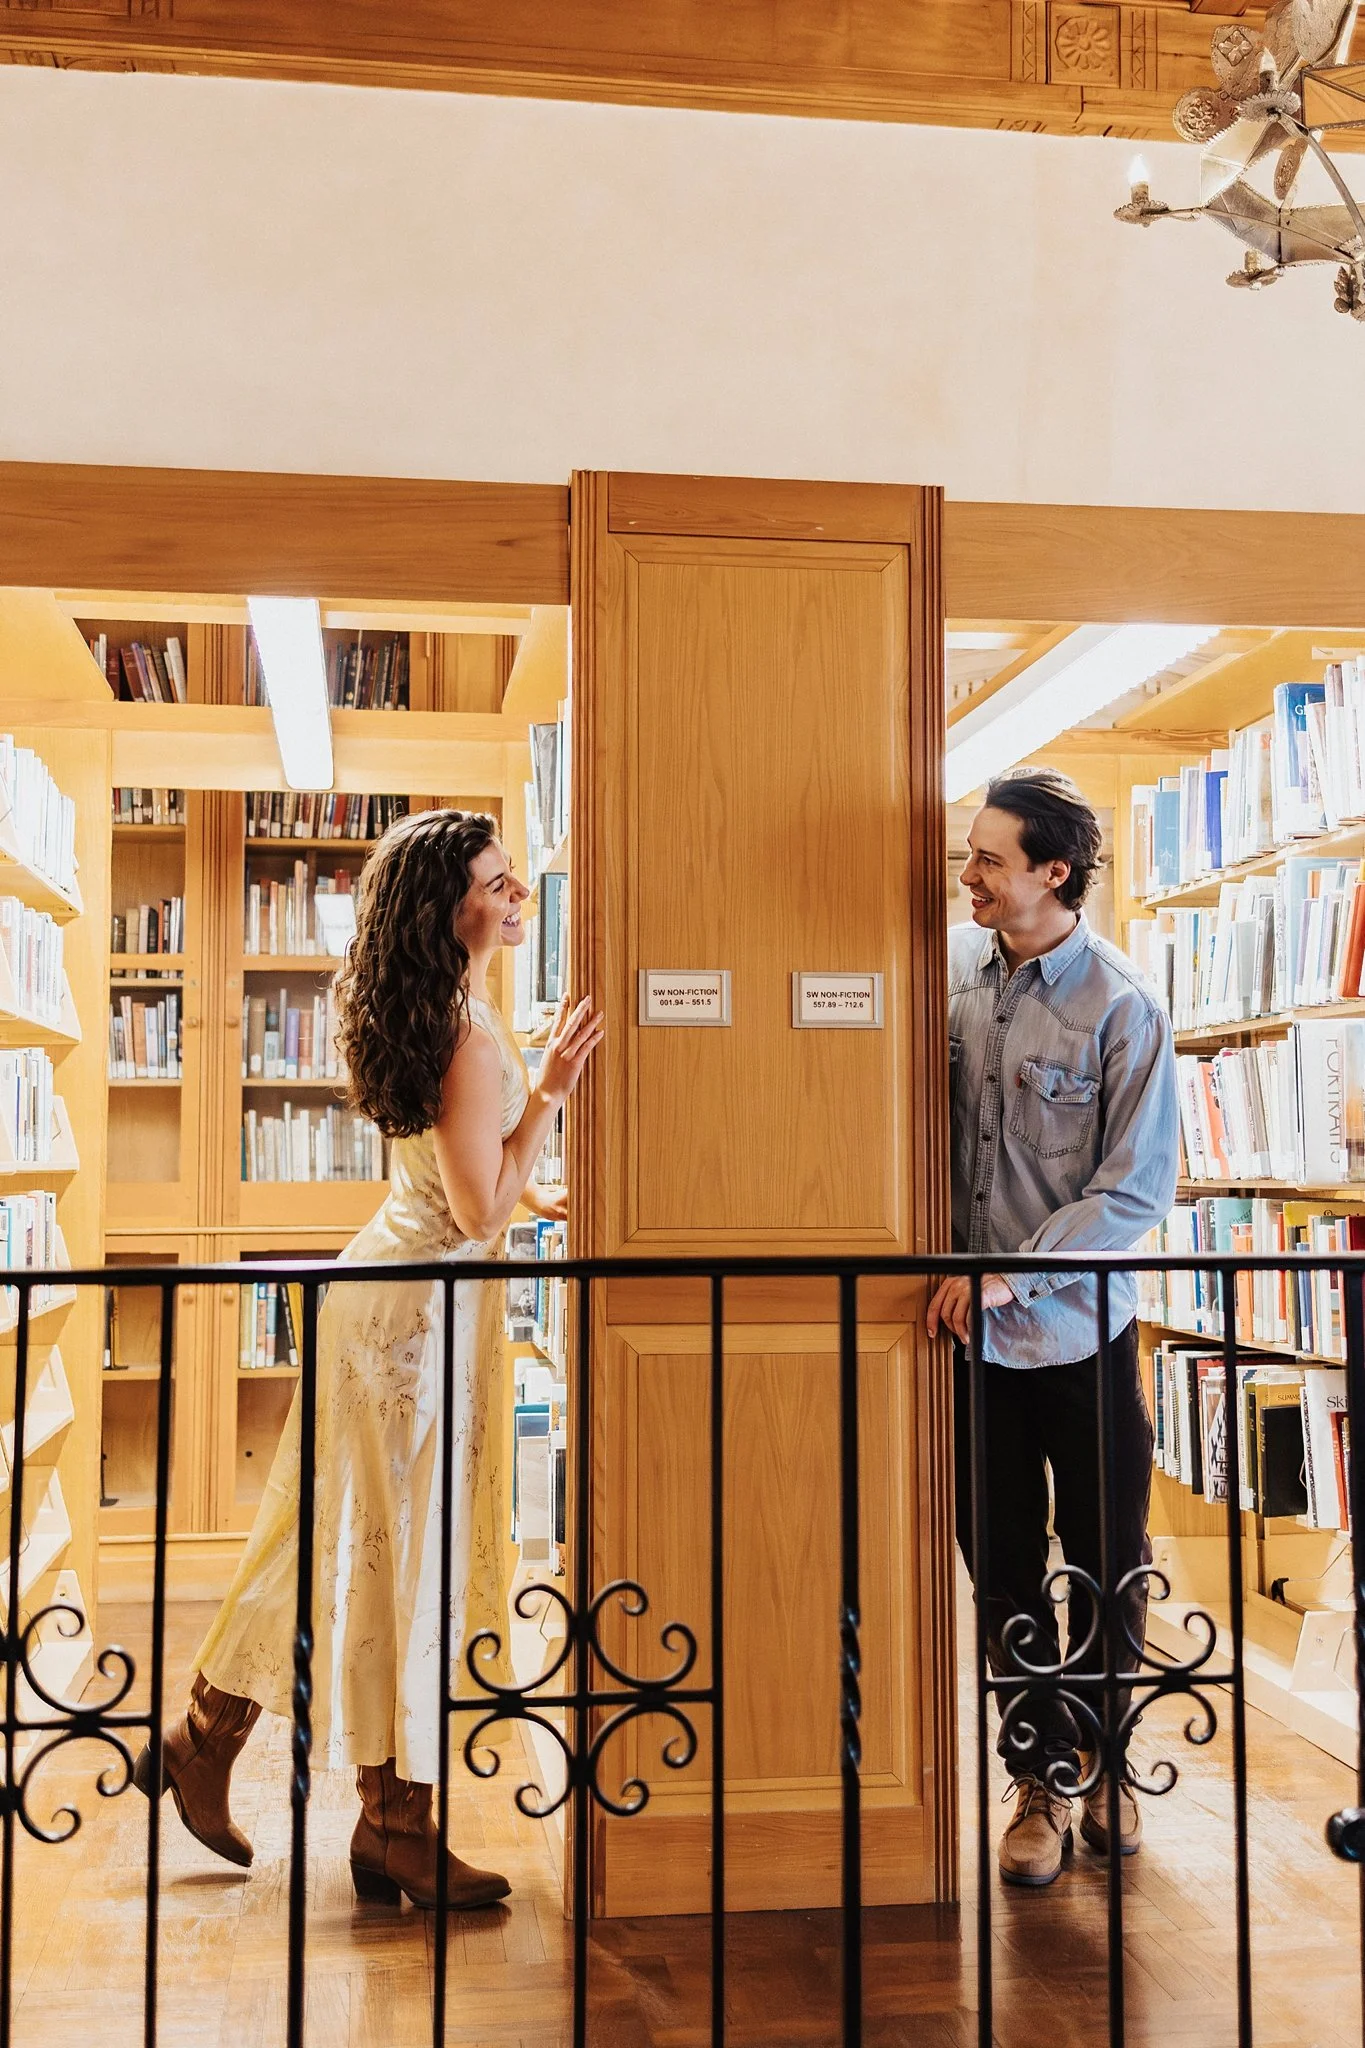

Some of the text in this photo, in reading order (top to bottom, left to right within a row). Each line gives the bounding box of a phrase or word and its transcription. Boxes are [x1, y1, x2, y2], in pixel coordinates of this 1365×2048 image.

[652, 988, 718, 997] SW NON-FICTION
[806, 991, 870, 999] SW NON-FICTION
[659, 998, 684, 1006] 001.94
[691, 998, 712, 1006] 551.5
